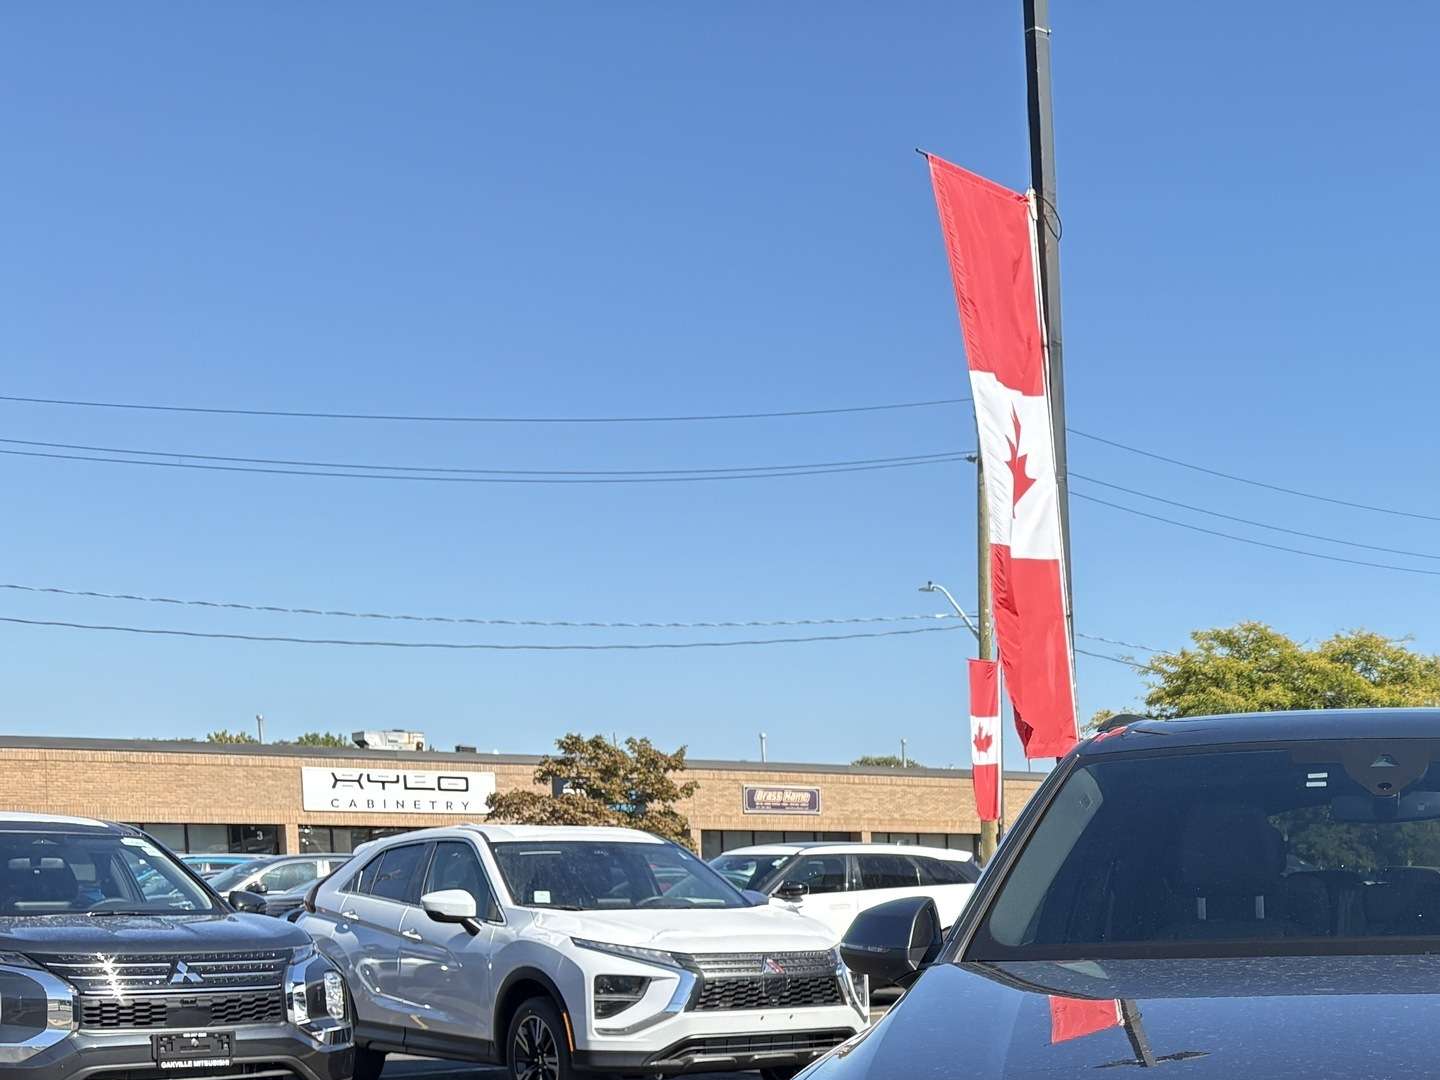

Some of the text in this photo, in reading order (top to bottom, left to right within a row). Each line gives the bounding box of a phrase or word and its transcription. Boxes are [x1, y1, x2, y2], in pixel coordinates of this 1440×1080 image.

[331, 772, 469, 792] XYLO
[331, 798, 471, 811] CABINETRY
[256, 831, 264, 840] 3
